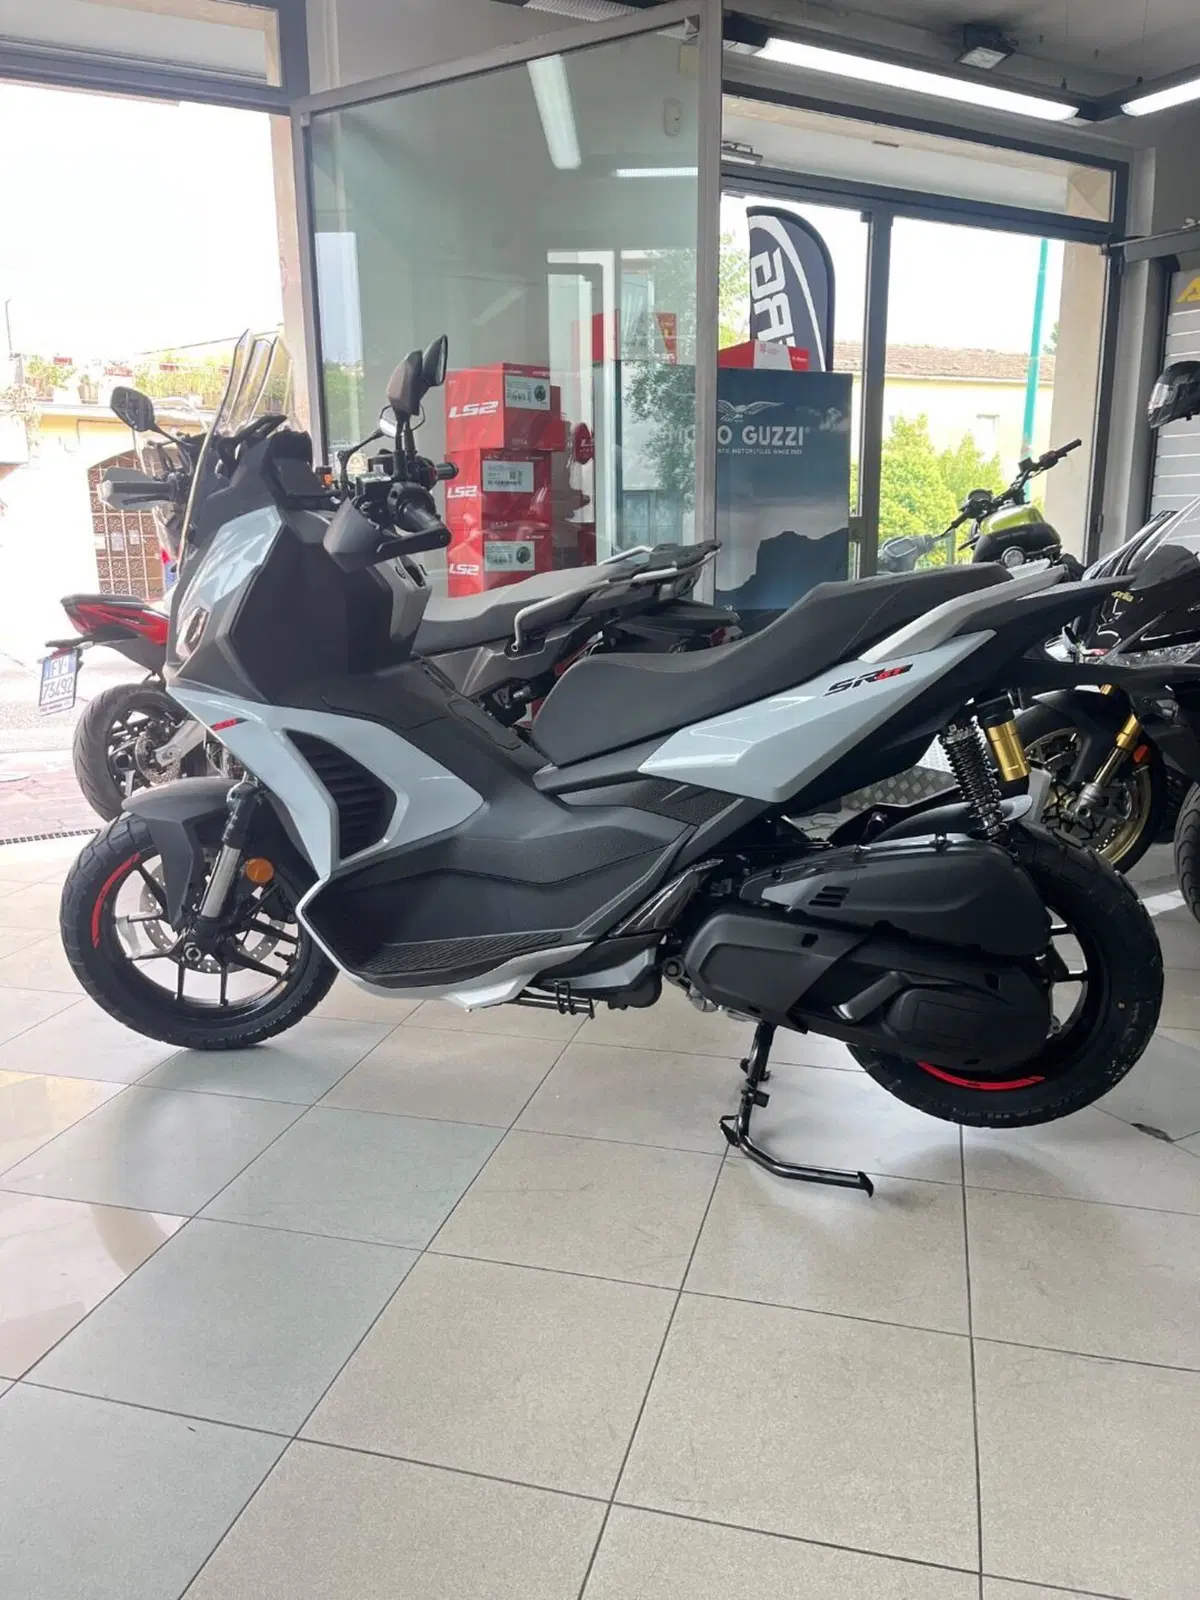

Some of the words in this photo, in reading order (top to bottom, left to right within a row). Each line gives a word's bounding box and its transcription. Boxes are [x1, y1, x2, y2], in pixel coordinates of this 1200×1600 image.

[448, 400, 499, 419] LS2
[741, 424, 804, 446] GUZZI
[446, 485, 478, 499] LS2
[448, 563, 480, 577] LS2
